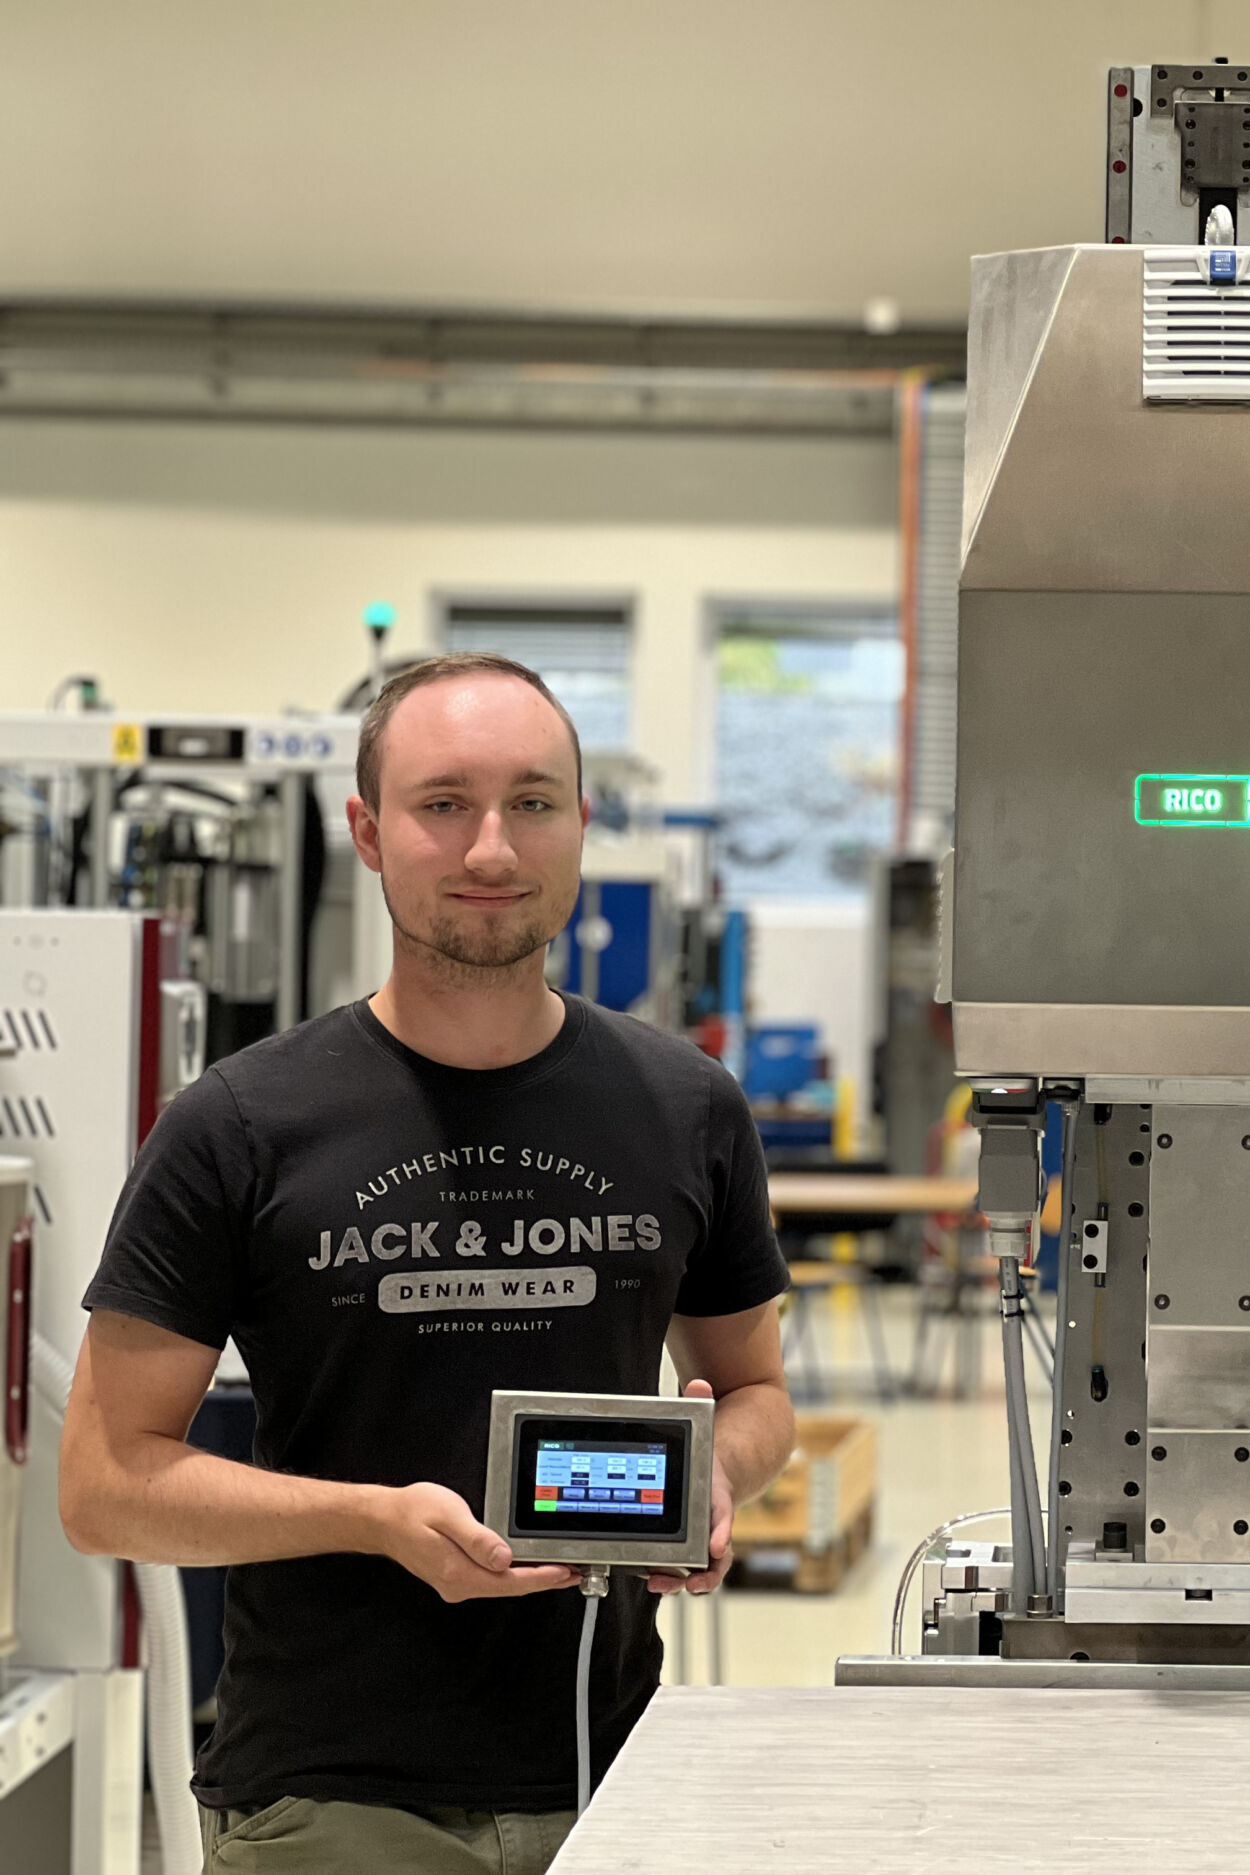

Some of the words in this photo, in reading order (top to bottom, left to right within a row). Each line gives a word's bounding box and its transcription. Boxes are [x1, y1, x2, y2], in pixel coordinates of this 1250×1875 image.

[1164, 788, 1222, 813] RICO
[356, 1146, 505, 1210] AUTHENTIC
[519, 1148, 614, 1196] SUPPLY
[439, 1189, 535, 1202] TRADEMARK
[308, 1221, 441, 1271] JACK
[455, 1220, 487, 1257] &
[500, 1213, 662, 1256] JONES
[399, 1282, 485, 1300] DENIM
[501, 1279, 575, 1296] WEAR
[614, 1278, 641, 1290] 1990
[331, 1293, 366, 1308] SINCE
[417, 1322, 484, 1334] SUPERIOR
[491, 1320, 553, 1332] QUALITY
